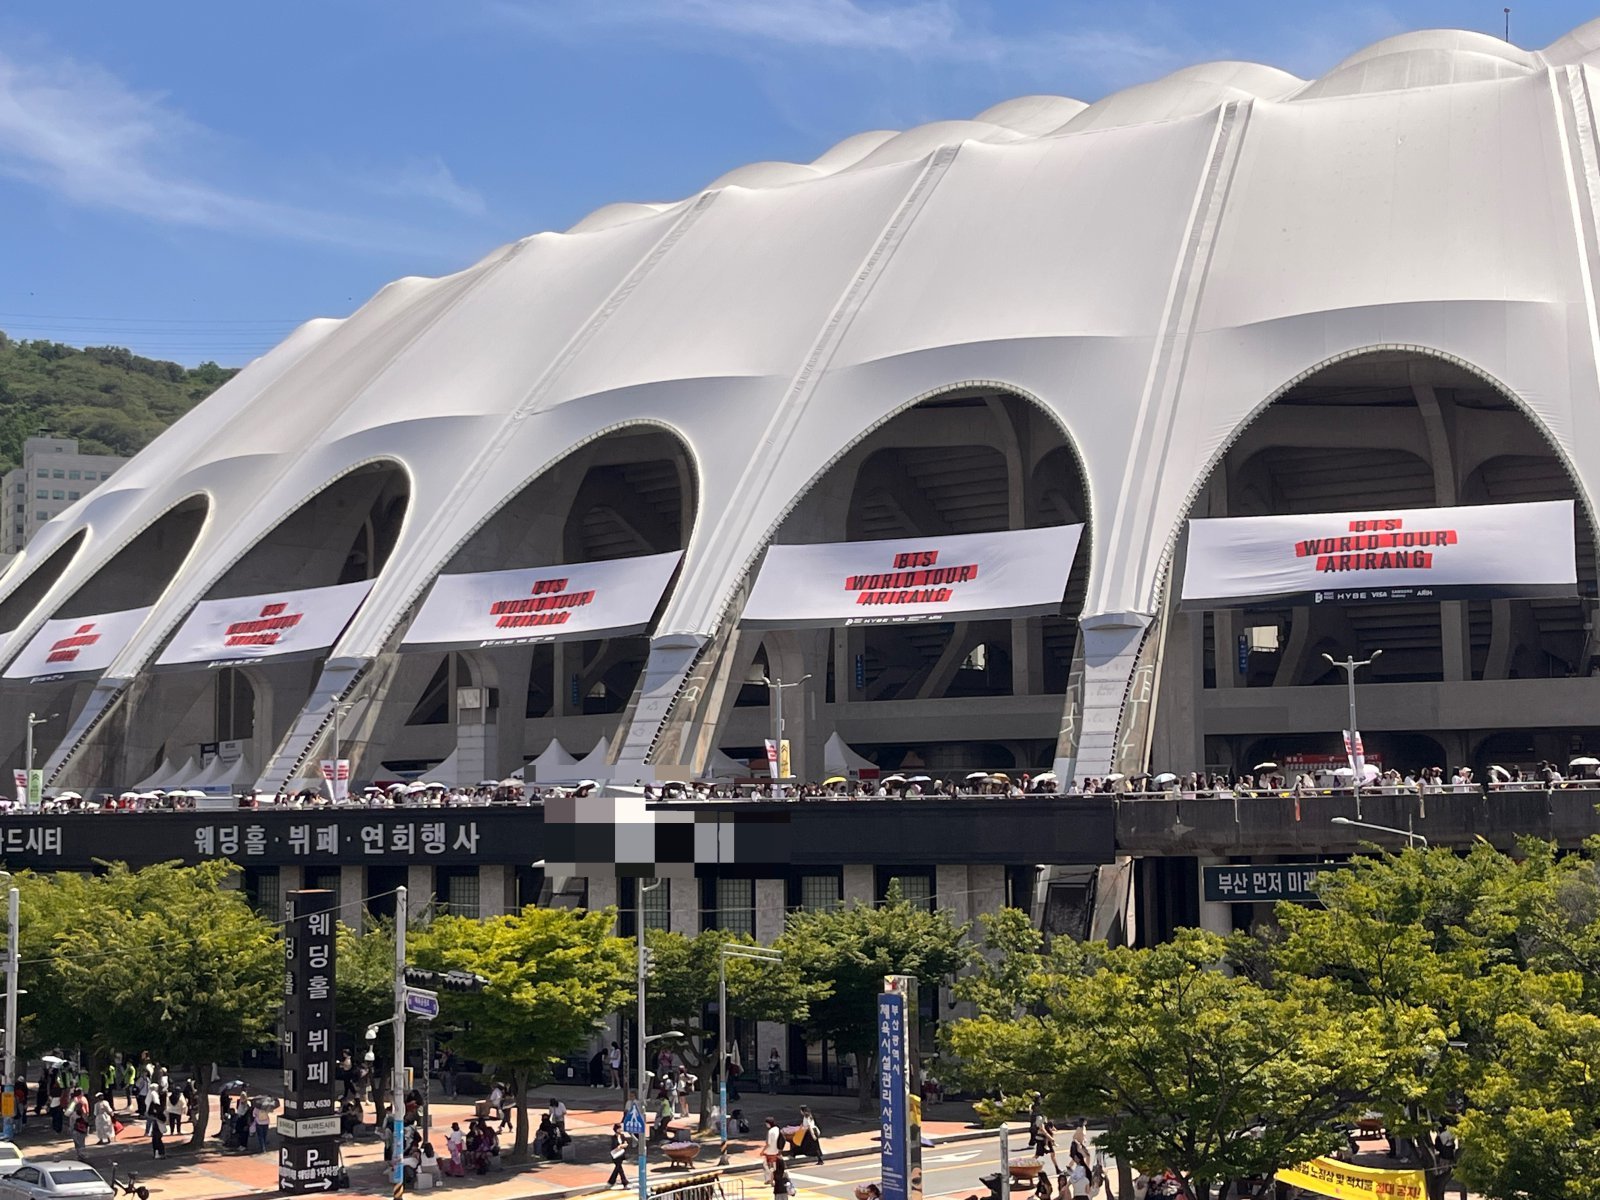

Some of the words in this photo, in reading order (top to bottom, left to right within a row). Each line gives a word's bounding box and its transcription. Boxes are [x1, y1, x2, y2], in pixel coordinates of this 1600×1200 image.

[1355, 519, 1396, 532] BTS
[1303, 534, 1379, 556] WORLD
[1390, 530, 1448, 547] TOUR
[897, 551, 933, 569] BTS
[1324, 550, 1425, 573] ARIRANG
[534, 578, 565, 595] BTS
[853, 571, 915, 590] WORLD
[921, 565, 971, 586] TOUR
[496, 598, 548, 614] WORLD
[552, 591, 589, 610] TOUR
[862, 587, 948, 606] ARIRANG
[1337, 592, 1367, 600] HYBE
[498, 611, 568, 629] ARIRANG
[1219, 873, 1248, 894] 부산
[1253, 872, 1282, 894] 먼저
